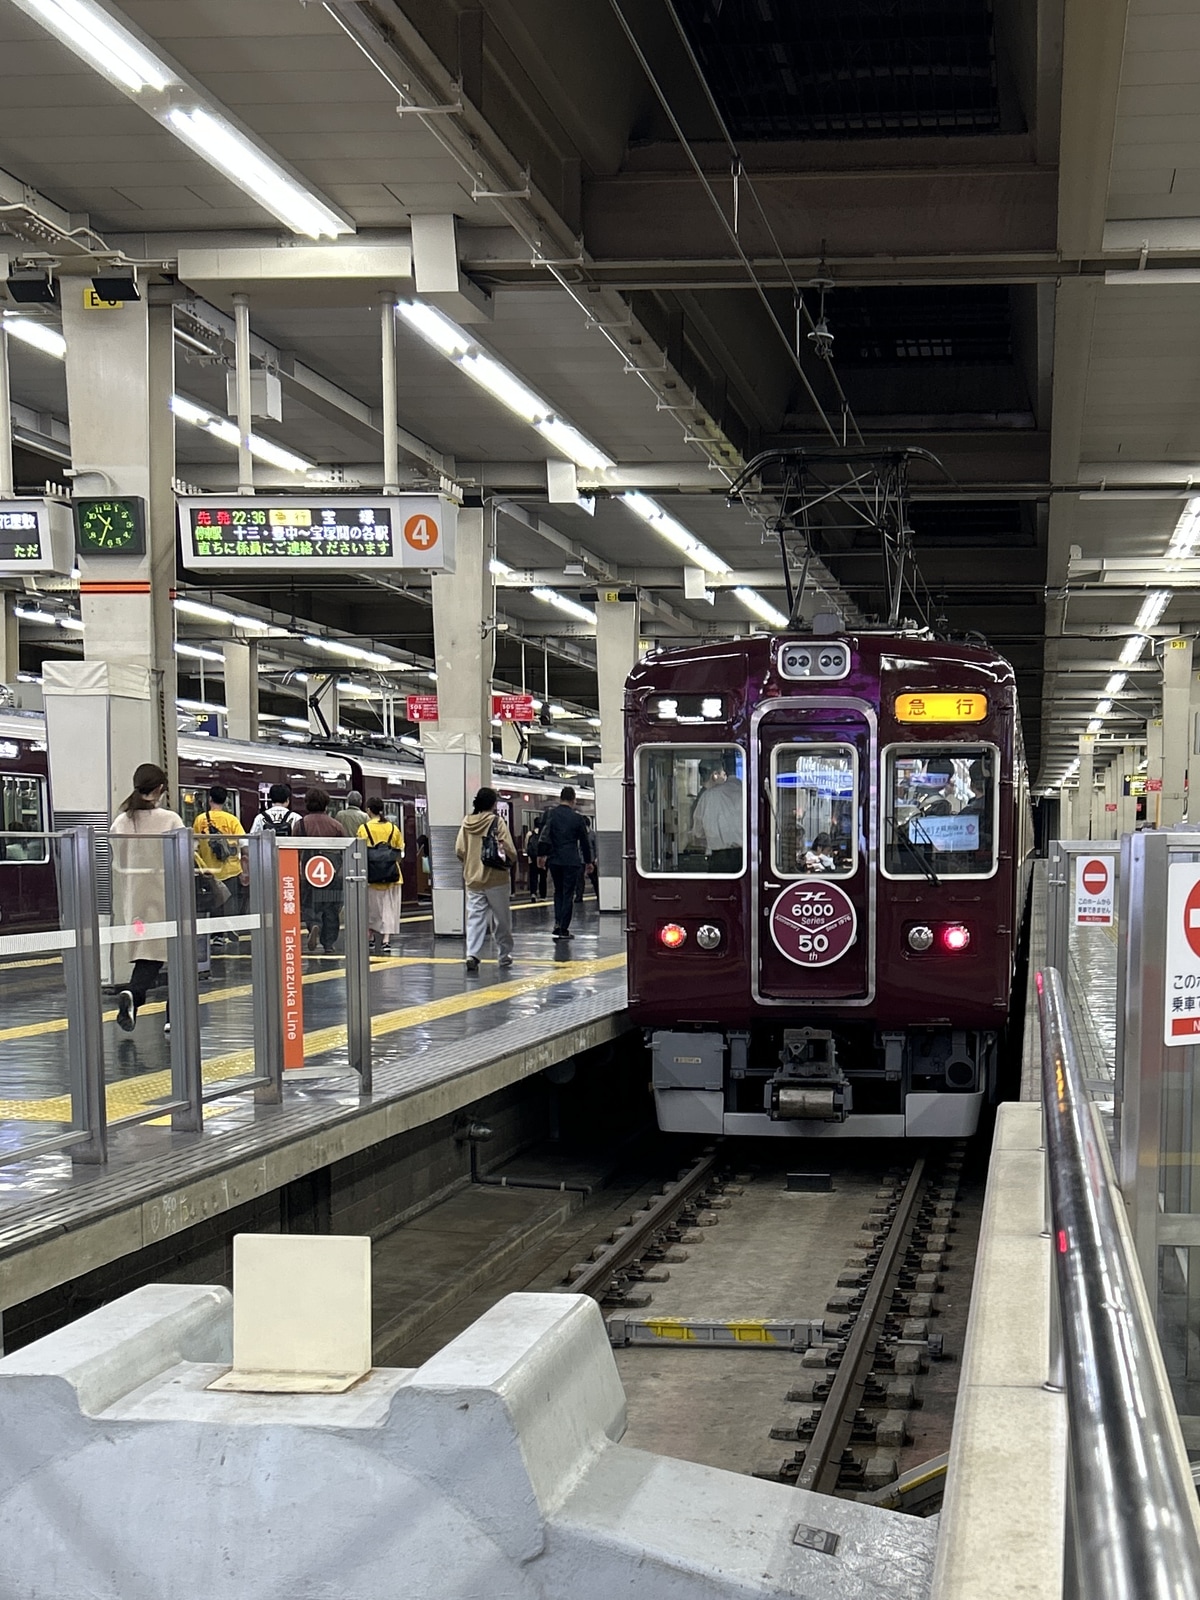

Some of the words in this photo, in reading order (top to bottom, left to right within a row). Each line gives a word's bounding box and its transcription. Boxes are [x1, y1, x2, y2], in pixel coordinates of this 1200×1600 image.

[103, 503, 111, 511] 12
[232, 511, 266, 525] 22:36
[412, 519, 429, 545] 4
[14, 544, 39, 557] ただ
[909, 699, 974, 716] 急行
[312, 862, 327, 882] 4
[282, 876, 296, 914] 宝塚線
[792, 904, 834, 916] 6000
[801, 917, 825, 925] Series
[798, 934, 829, 952] 50
[809, 952, 818, 961] th
[284, 927, 296, 1007] Takarazuka
[286, 1011, 298, 1040] Line
